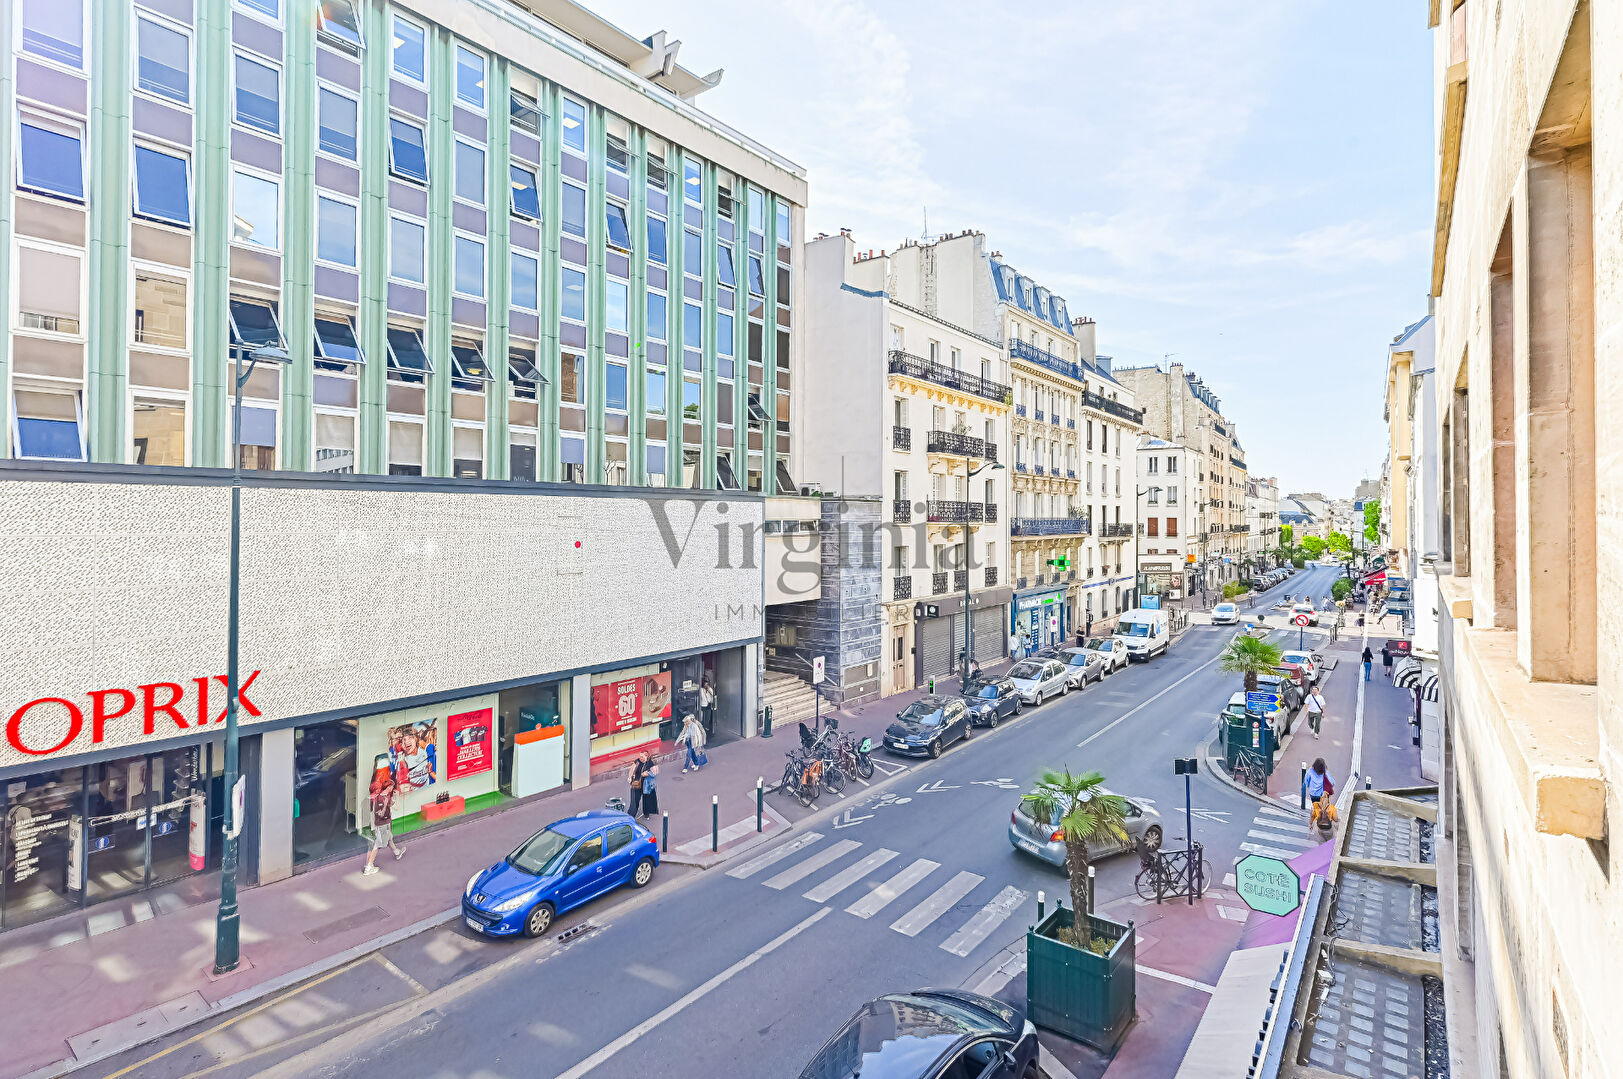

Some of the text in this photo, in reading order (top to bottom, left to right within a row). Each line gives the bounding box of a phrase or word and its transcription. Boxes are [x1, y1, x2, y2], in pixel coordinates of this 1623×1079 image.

[617, 683, 636, 696] SOLDES
[6, 669, 263, 756] OPRIX
[1243, 882, 1292, 904] SUSHI
